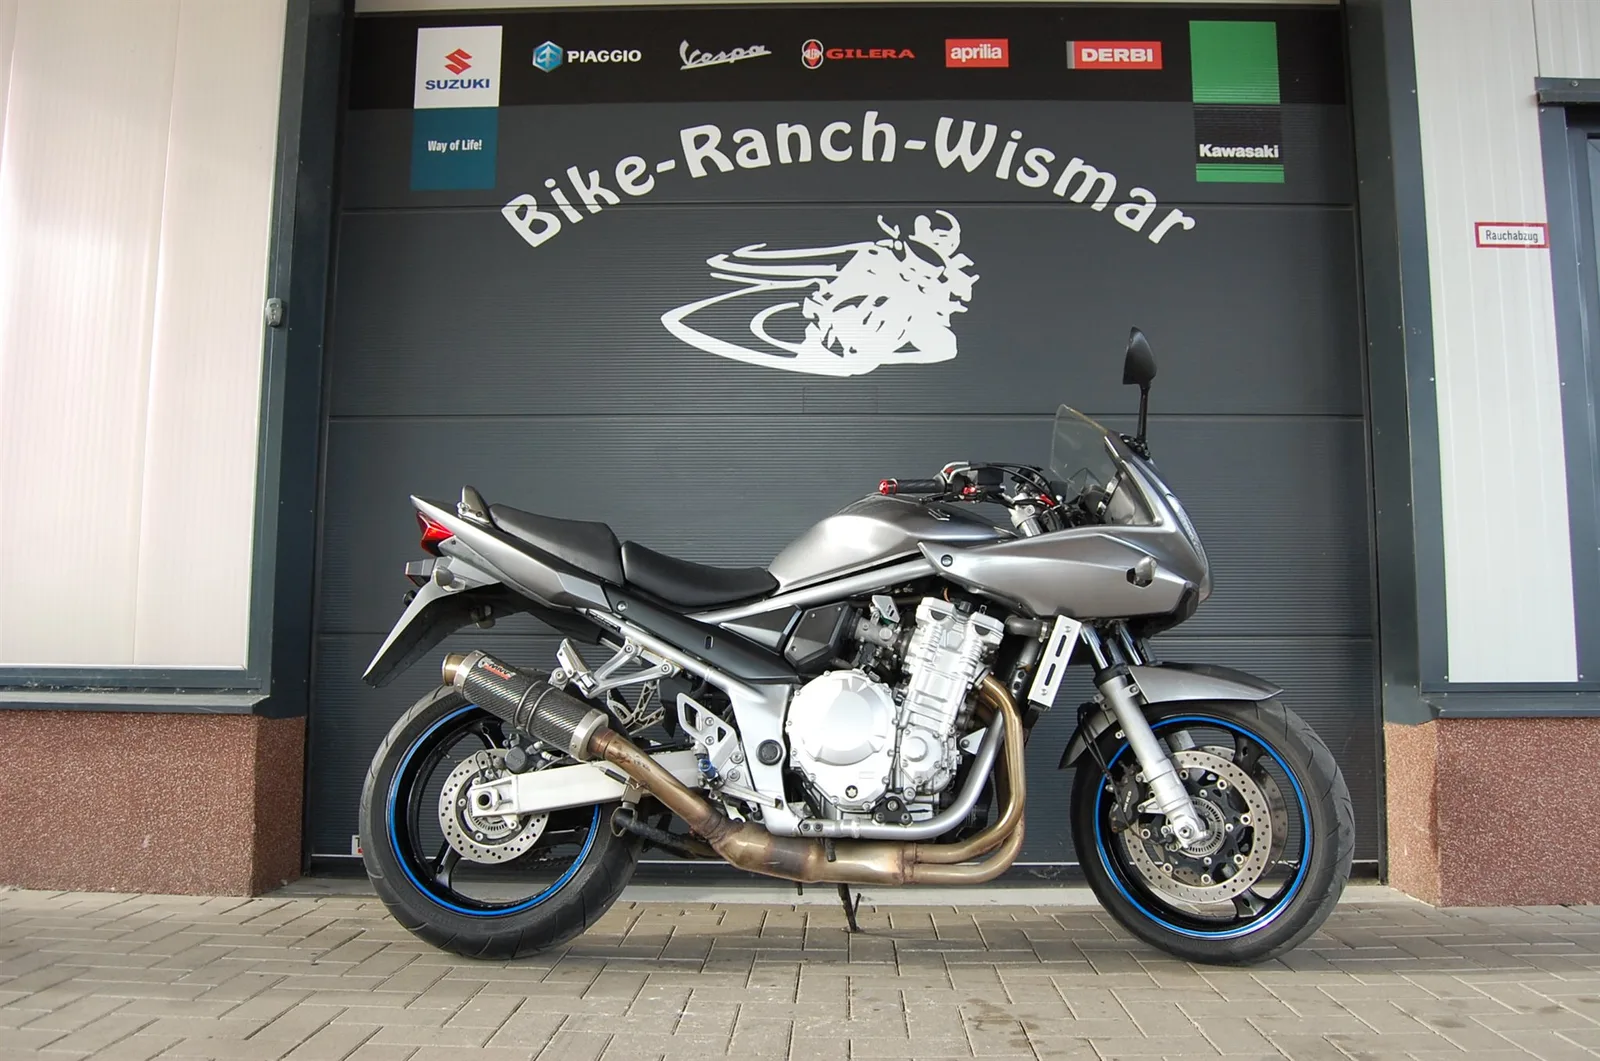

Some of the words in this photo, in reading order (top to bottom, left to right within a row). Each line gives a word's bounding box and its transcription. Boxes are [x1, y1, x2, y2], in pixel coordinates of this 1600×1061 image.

[567, 50, 642, 63] PIAGGIO
[680, 40, 772, 70] Vespa
[826, 48, 916, 59] GILERA
[950, 43, 1002, 63] aprilia
[1081, 48, 1154, 62] DERBI
[425, 78, 490, 91] SUZUKI
[427, 140, 448, 153] Way
[449, 140, 460, 151] of
[461, 139, 482, 151] Life!
[1199, 144, 1280, 159] Kawasaki
[501, 110, 1196, 247] Bike-Ranch-Wismar
[1485, 229, 1539, 243] Rauchabzug
